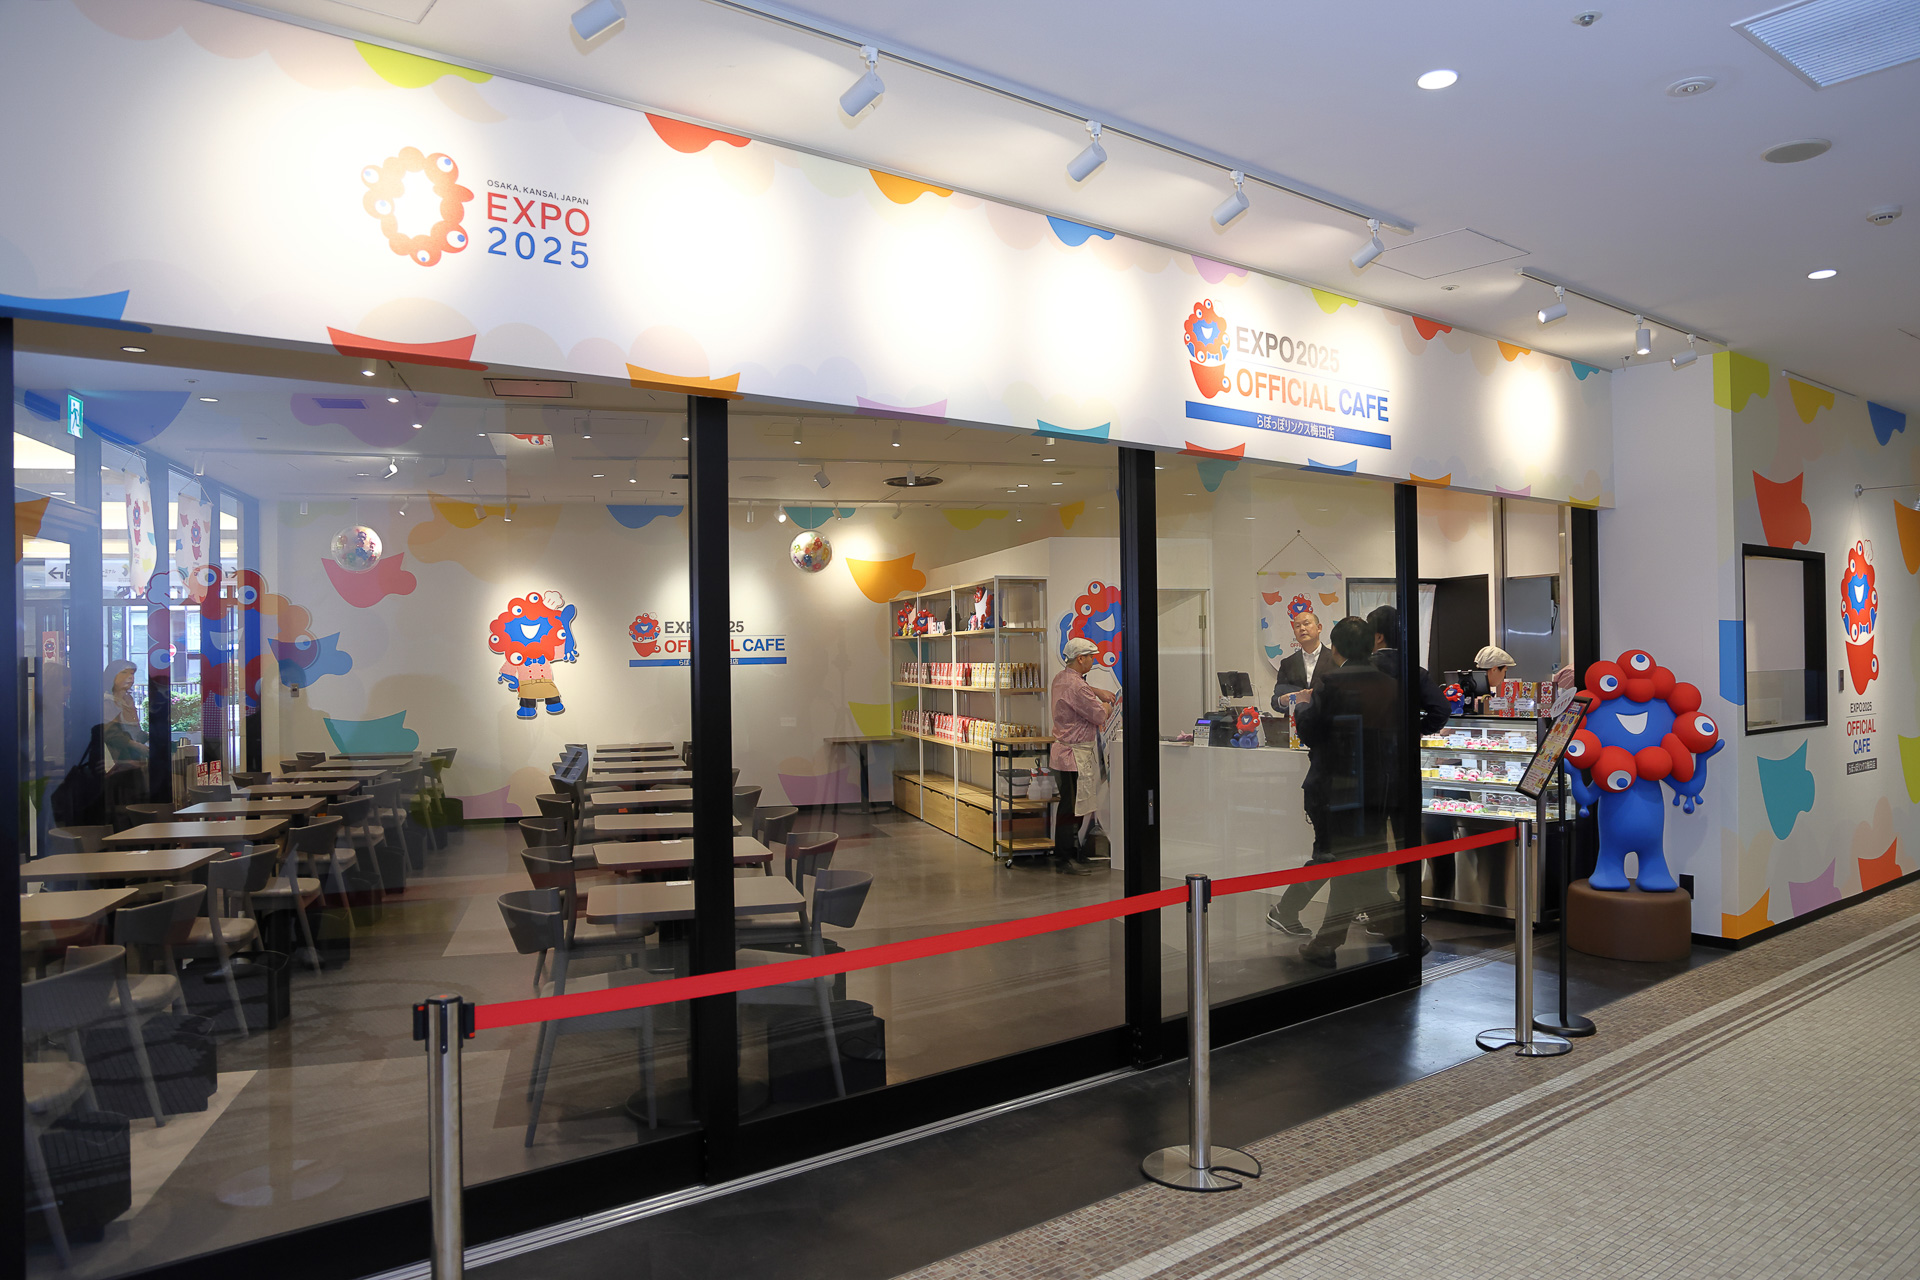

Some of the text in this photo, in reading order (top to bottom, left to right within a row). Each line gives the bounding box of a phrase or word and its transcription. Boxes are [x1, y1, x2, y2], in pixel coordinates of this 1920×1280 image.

[487, 179, 589, 206] OSAKA, KANSAI, JAPAN
[488, 192, 590, 237] EXPO
[487, 226, 589, 269] 2025
[1236, 368, 1390, 422] OFFICIAL CAFE
[1256, 414, 1335, 440] らぽっぽリンクス梅田店
[742, 638, 786, 652] CAFE
[1846, 718, 1877, 737] OFFICIAL
[1853, 737, 1871, 755] CAFE
